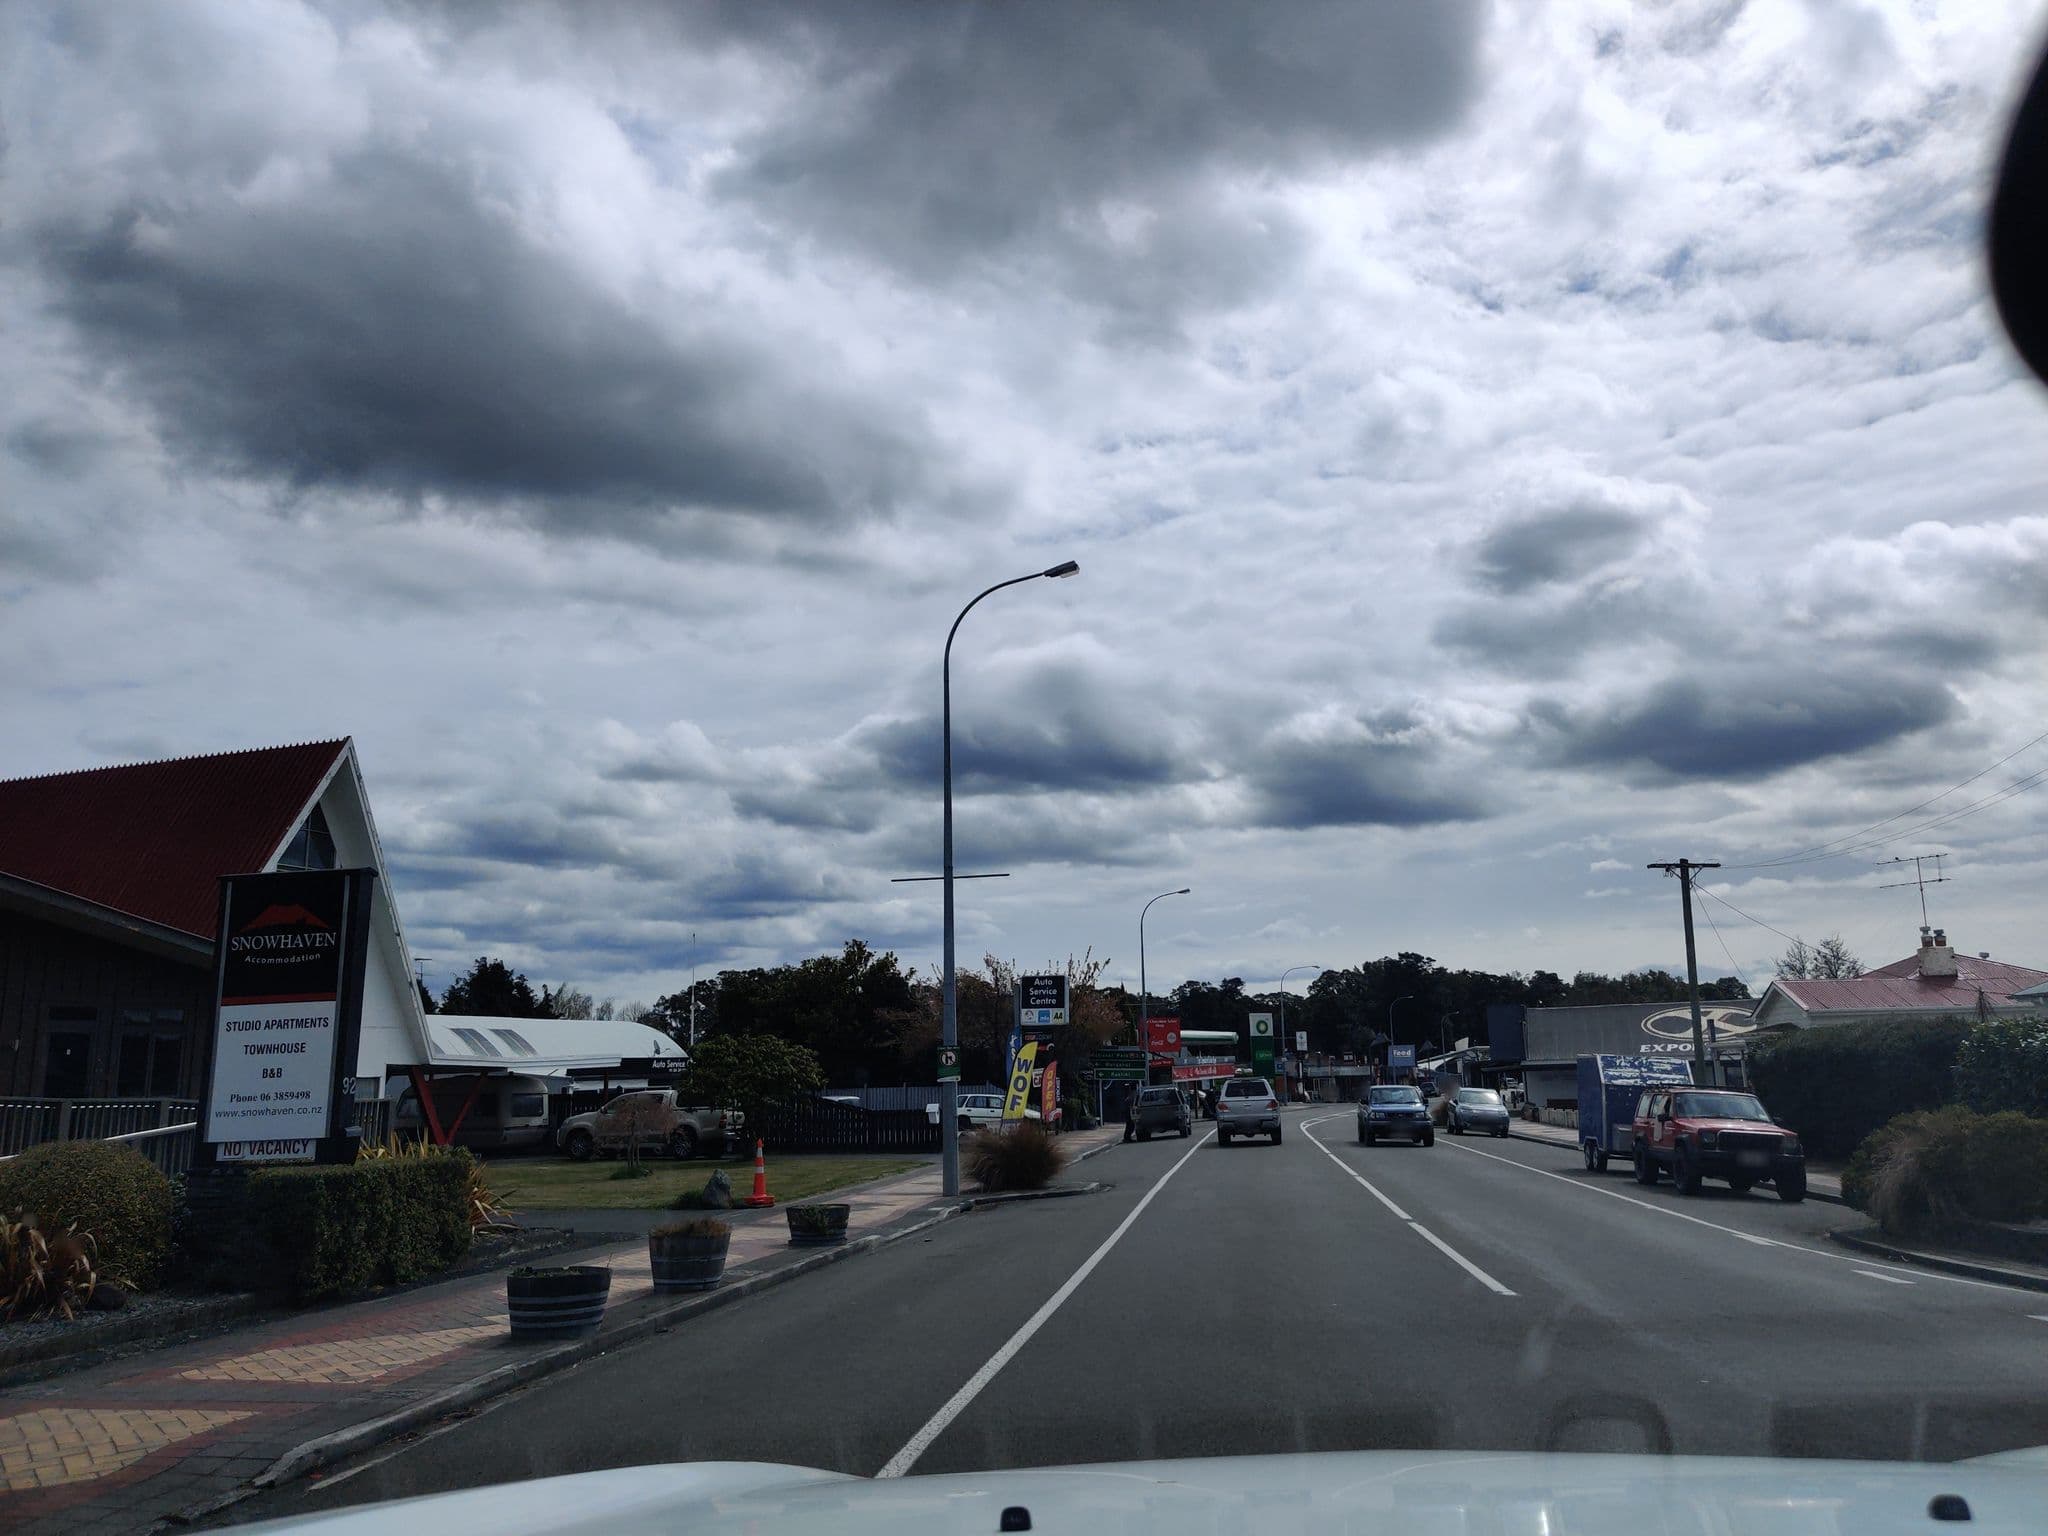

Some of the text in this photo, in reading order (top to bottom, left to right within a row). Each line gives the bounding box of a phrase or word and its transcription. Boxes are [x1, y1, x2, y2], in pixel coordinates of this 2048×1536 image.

[231, 932, 336, 951] SNOWHAVEN
[244, 953, 321, 964] Accommodation
[1033, 977, 1053, 986] Auto
[1029, 987, 1057, 996] Service
[1030, 997, 1057, 1005] Centre
[226, 1017, 329, 1032] STUDIO APARTMENTS
[244, 1042, 307, 1056] TOWNHOUSE
[1640, 1043, 1696, 1053] EXPO
[652, 1060, 666, 1068] Auto
[666, 1059, 686, 1068] Service
[262, 1068, 283, 1079] B&B
[342, 1076, 356, 1095] 92
[1009, 1057, 1033, 1111] WOF
[1046, 1070, 1055, 1111] OPEN
[230, 1091, 311, 1103] Phone 06 3859498
[215, 1106, 322, 1119] www.snowhaven.co.nz
[223, 1139, 310, 1157] NO VACANCY
